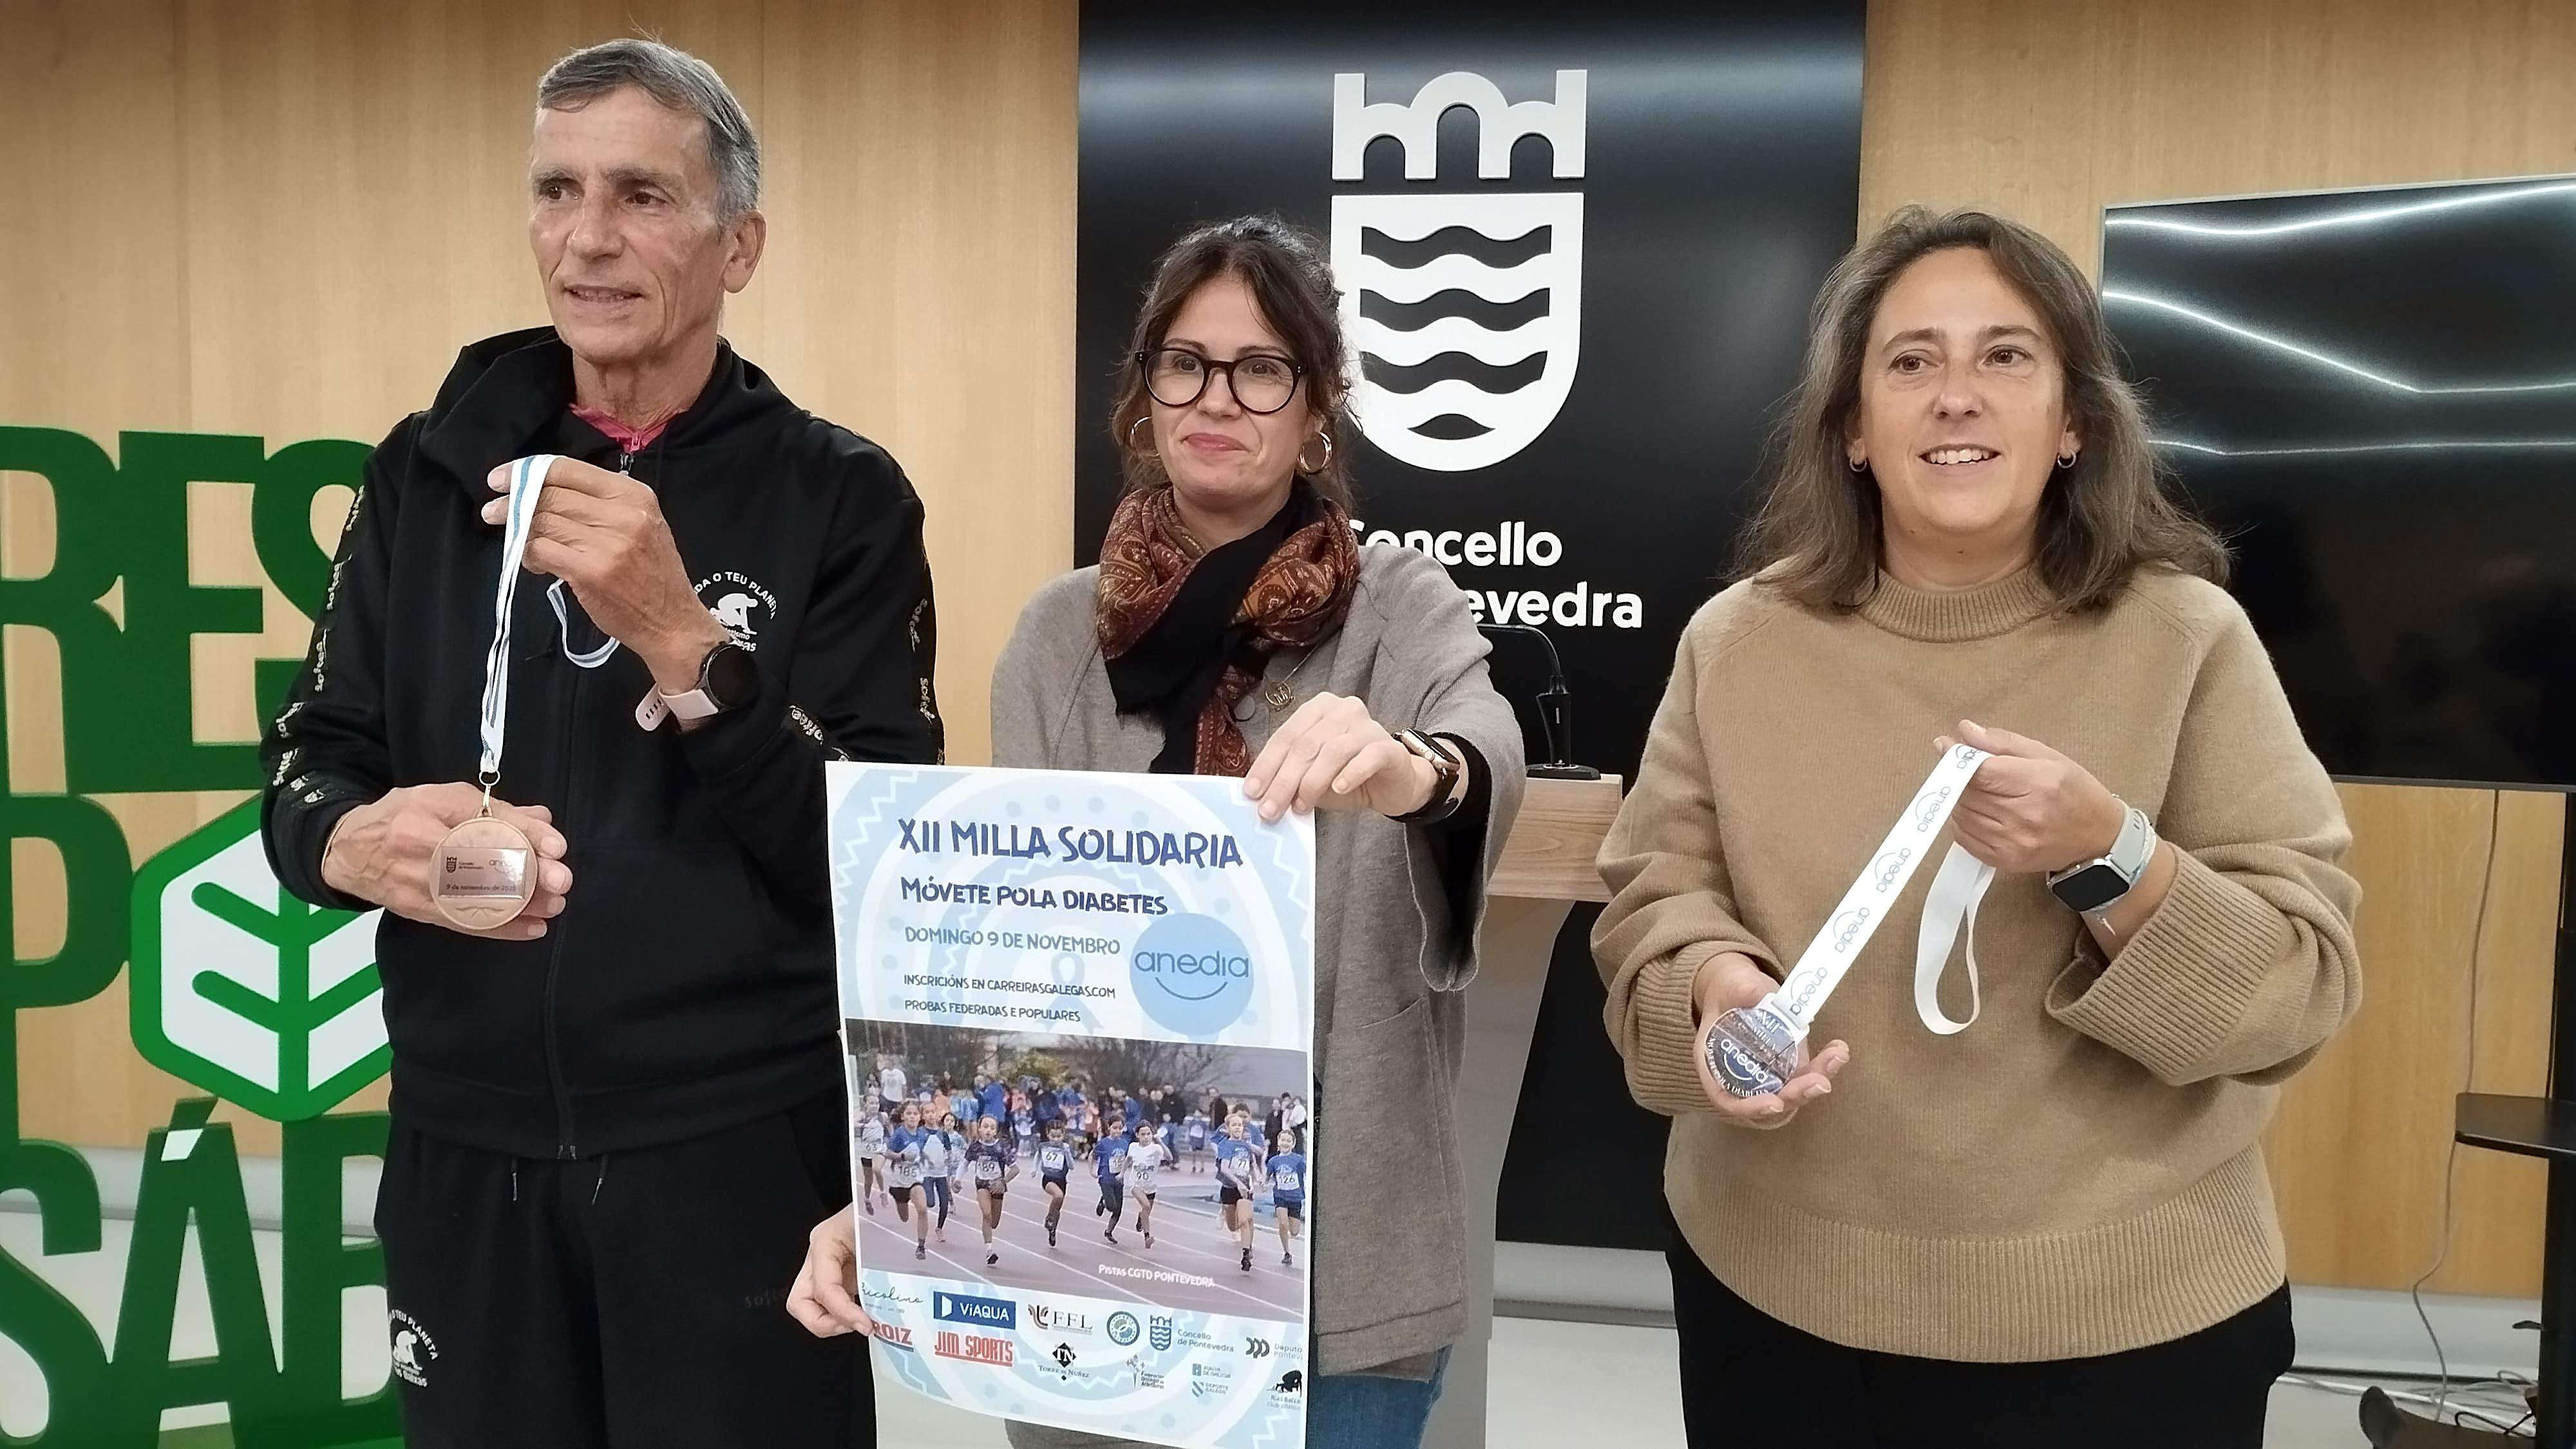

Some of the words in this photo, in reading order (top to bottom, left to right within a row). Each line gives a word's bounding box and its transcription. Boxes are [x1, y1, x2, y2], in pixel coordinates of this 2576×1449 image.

[694, 578, 712, 595] DA
[712, 573, 722, 582] O
[724, 571, 748, 585] TEU
[1465, 581, 1643, 629] evedra
[1917, 785, 1952, 833] anedia
[898, 819, 940, 854] XII
[951, 820, 1051, 860] MILLA
[1062, 825, 1244, 869] SOLIDARIA
[1876, 847, 1911, 894] anedia
[901, 875, 992, 906] MÓVETE
[997, 886, 1058, 910] POLA
[1063, 889, 1169, 916] DIABETES
[905, 926, 984, 946] DOMINGO
[987, 931, 999, 946] 9
[1003, 932, 1024, 949] DE
[1027, 933, 1121, 955] NOVEMBRO
[1834, 906, 1871, 954] anedia
[1135, 950, 1249, 978] anedia
[904, 974, 969, 989] INSCRICIÓNS
[972, 979, 985, 990] EN
[1790, 966, 1828, 1018] anedia
[904, 1000, 947, 1013] PROBAS
[949, 1003, 1009, 1017] FEDERADAS
[1010, 1007, 1017, 1018] E
[1019, 1008, 1081, 1022] POPULARES
[1720, 1038, 1768, 1084] anedia
[1128, 1267, 1153, 1280] CGTD
[1154, 1271, 1216, 1287] PONTEVEDRA
[871, 1320, 913, 1345] ROIZ
[934, 1331, 960, 1354] JIM
[965, 1334, 1014, 1362] SPORTS
[1177, 1329, 1211, 1340] Concello
[1189, 1339, 1235, 1352] Pontevedra
